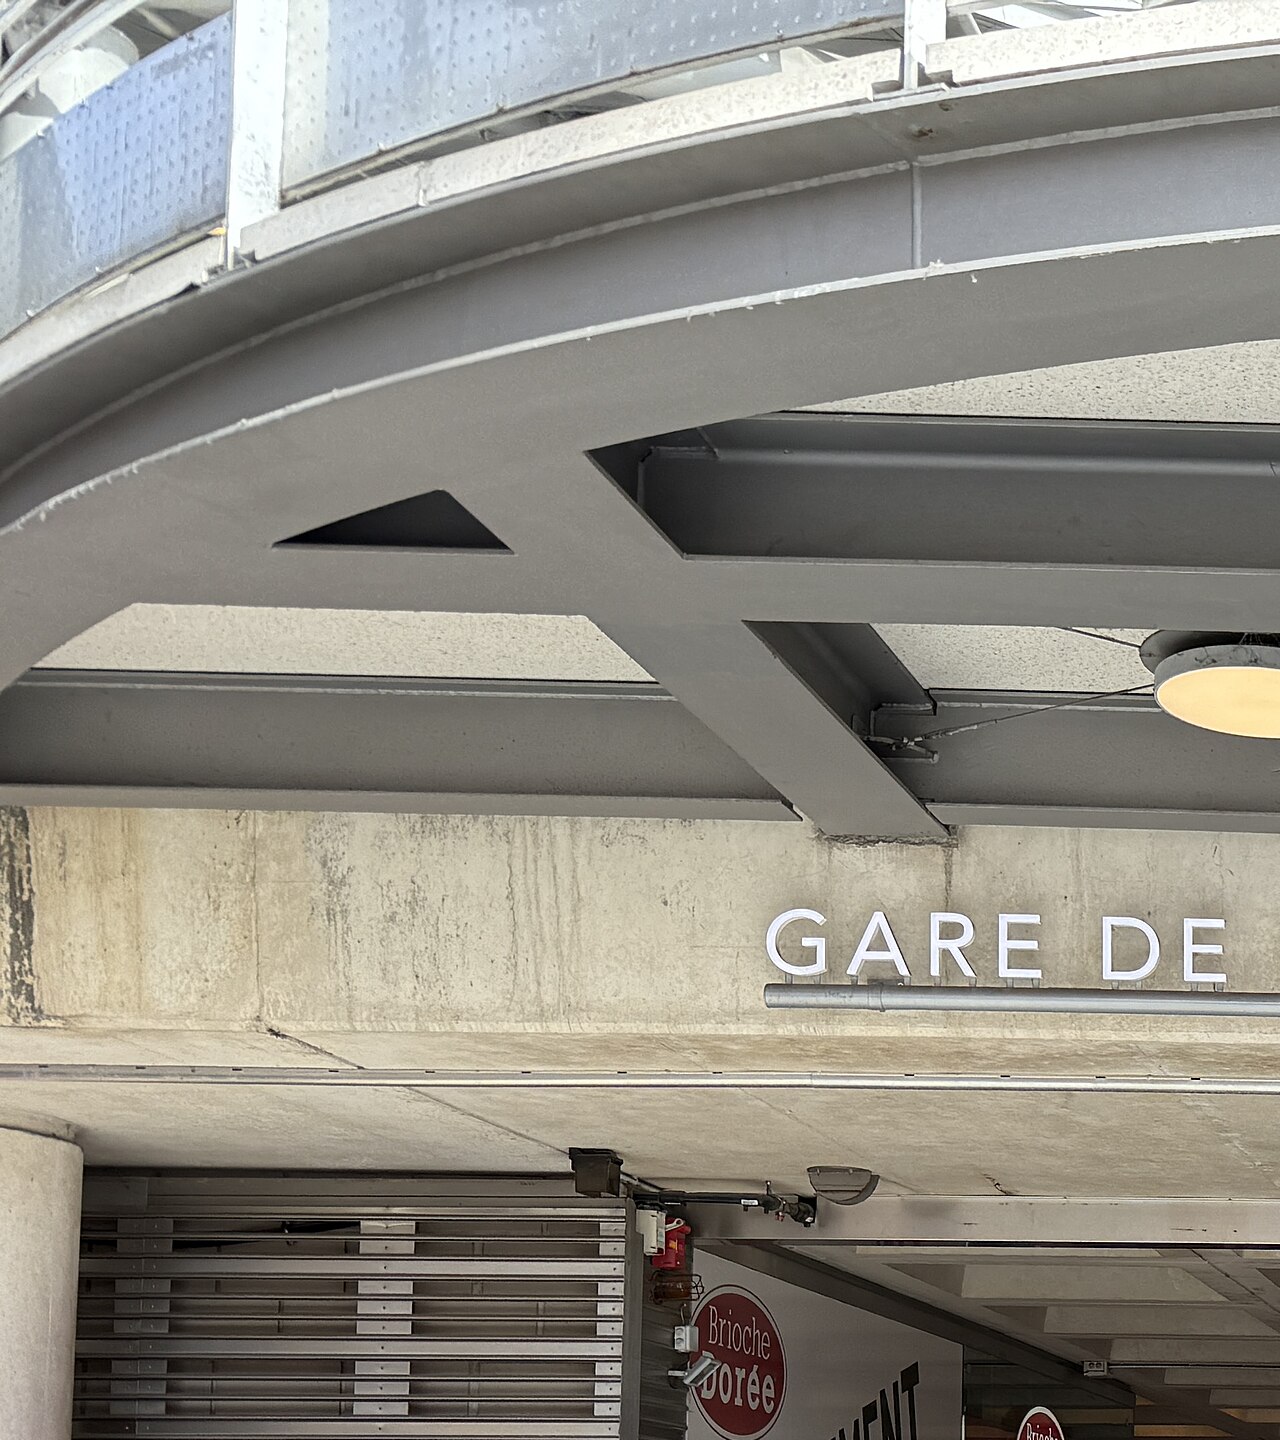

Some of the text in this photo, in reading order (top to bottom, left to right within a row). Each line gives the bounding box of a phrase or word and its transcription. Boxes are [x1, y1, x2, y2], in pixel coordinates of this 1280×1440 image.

[765, 908, 1042, 980] GARE
[1102, 916, 1227, 983] DE
[707, 1305, 771, 1361] Brioche
